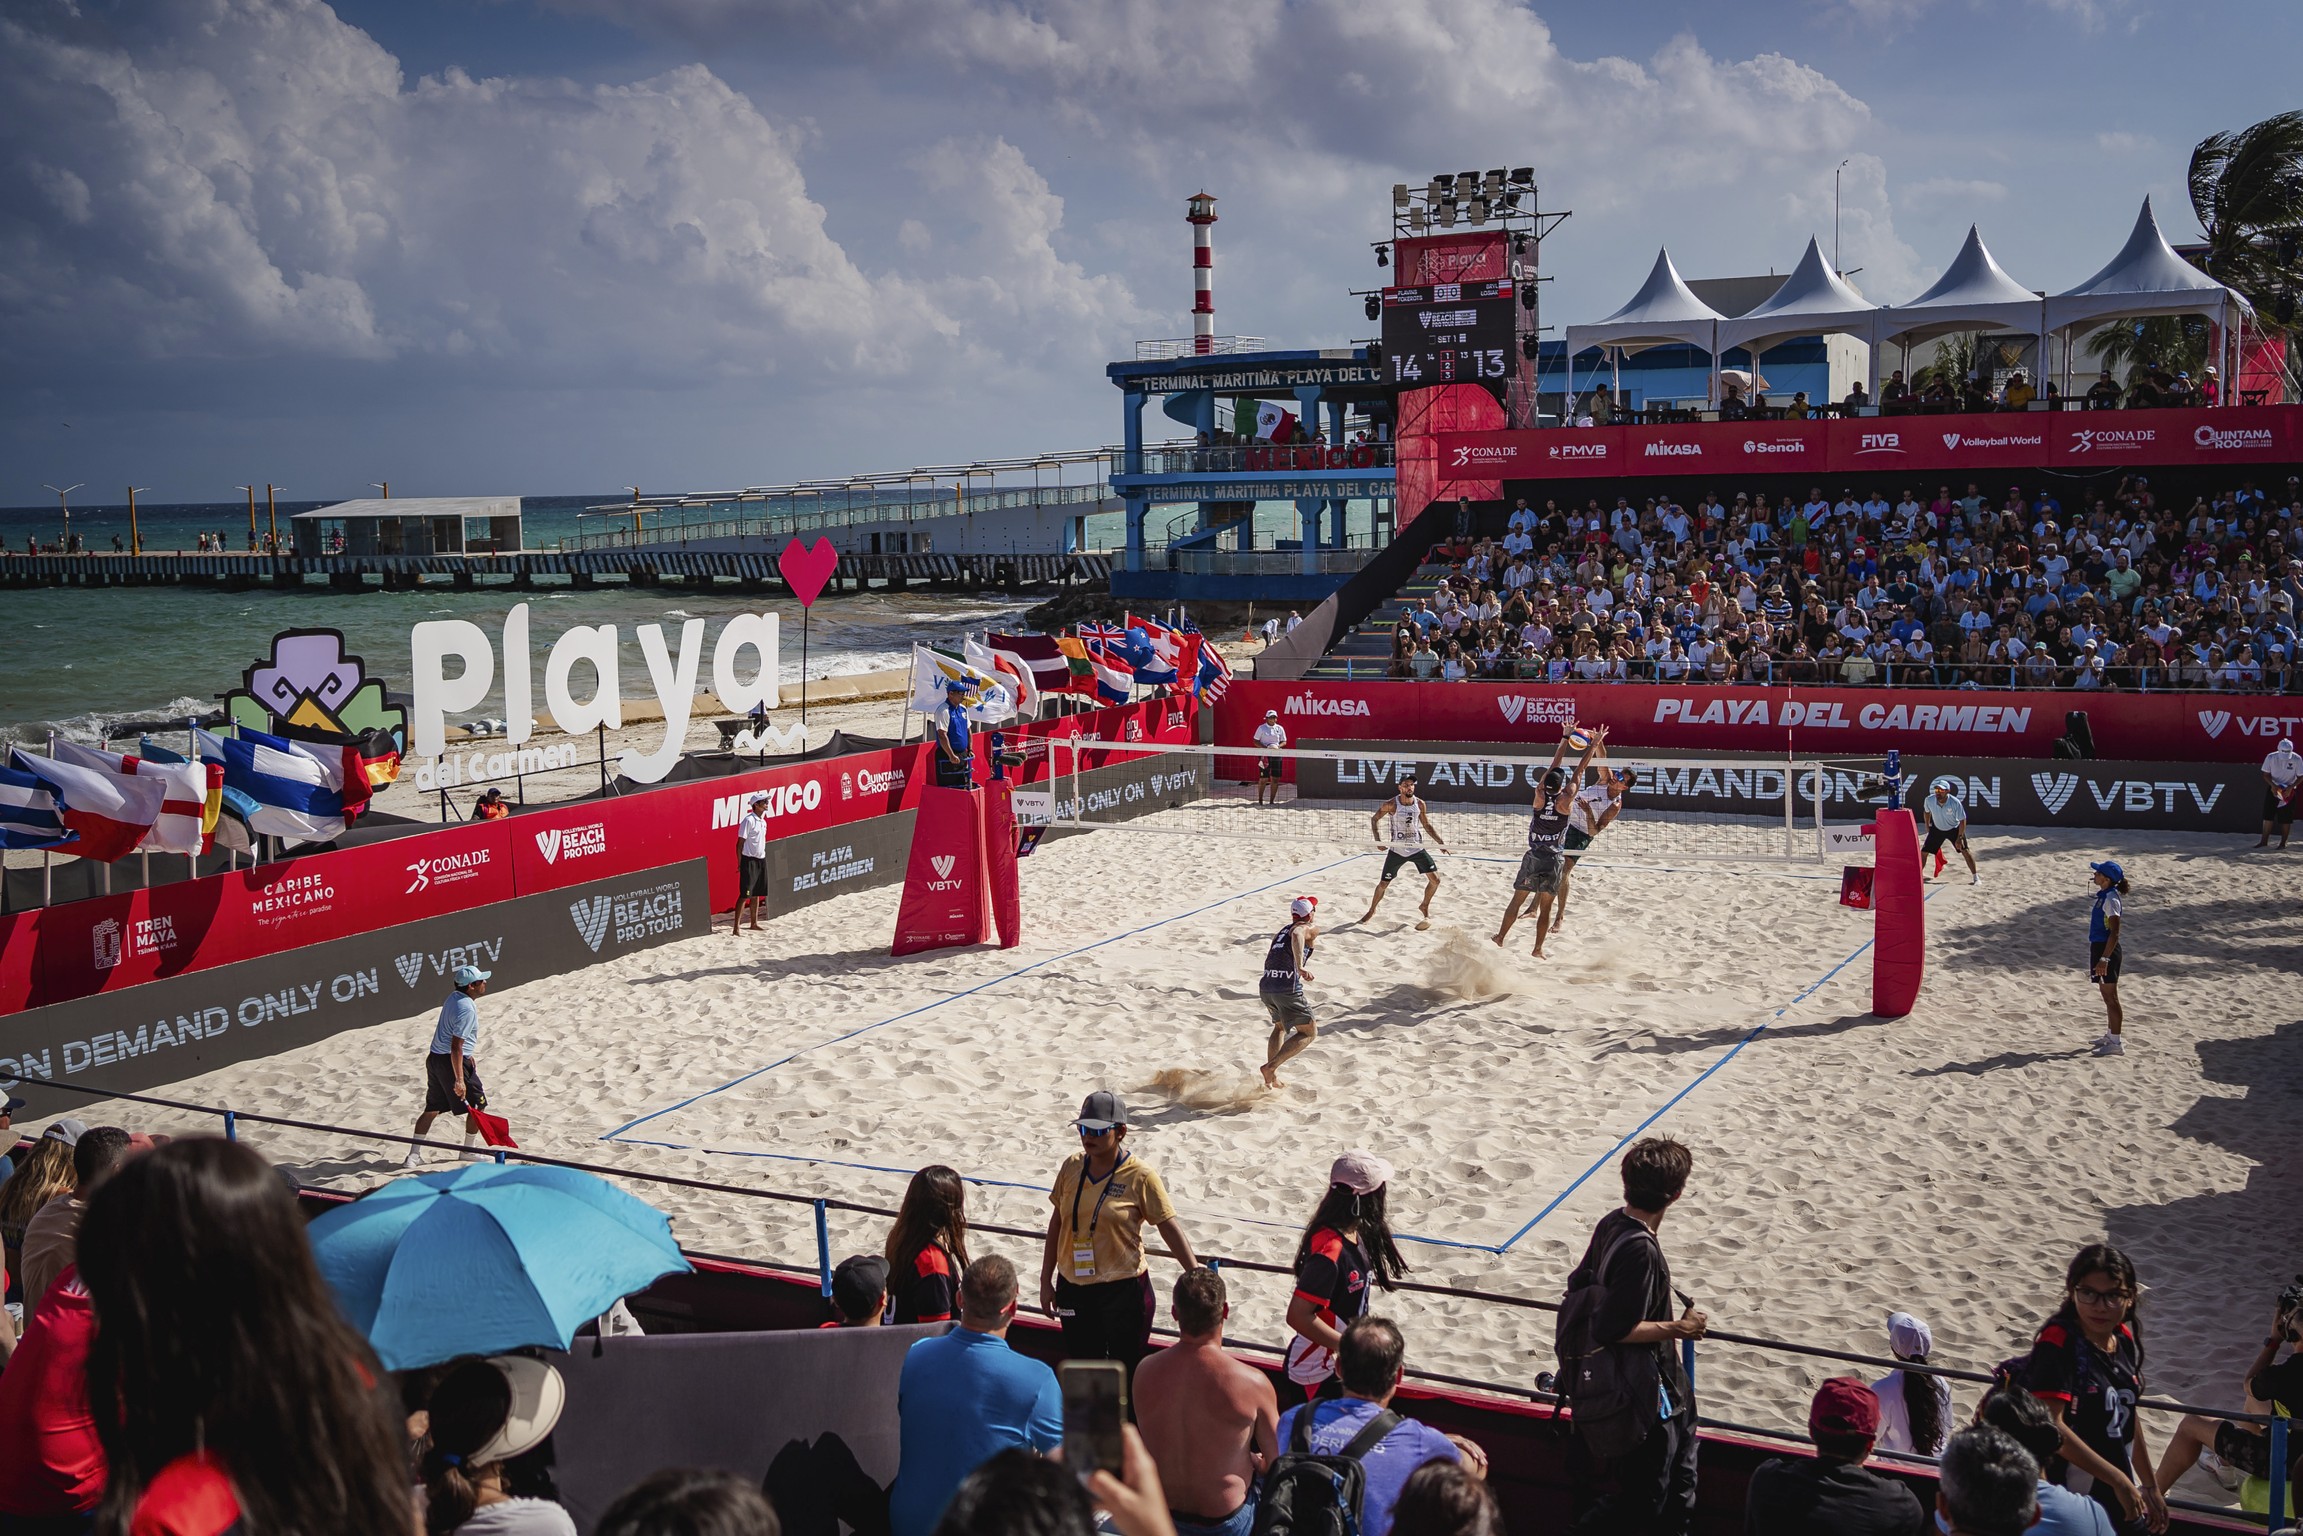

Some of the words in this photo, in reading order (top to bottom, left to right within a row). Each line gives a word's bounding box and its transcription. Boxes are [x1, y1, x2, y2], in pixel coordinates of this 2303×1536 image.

[1448, 252, 1486, 269] Playa
[1437, 287, 1445, 298] 0
[1450, 287, 1458, 297] 0
[1432, 314, 1455, 322] BEACH
[1437, 335, 1452, 343] SET
[1391, 354, 1422, 381] 14
[1473, 349, 1506, 378] 13
[1143, 375, 1207, 391] TERMINAL
[1213, 370, 1279, 389] MARITIMA
[1287, 369, 1332, 385] PLAYA
[1339, 367, 1365, 382] DEL
[1862, 433, 1899, 447] FIVB
[1962, 436, 2008, 447] Volleyball
[2010, 434, 2041, 446] World
[2096, 430, 2155, 442] CONADE
[2194, 425, 2272, 445] QUINTANA
[2215, 439, 2242, 449] ROO
[1472, 446, 1517, 457] CONADE
[1563, 444, 1607, 456] FMVB
[1757, 442, 1804, 453] Senoh
[1146, 485, 1209, 501] TERMINAL
[1215, 484, 1279, 499] MARITIMA
[1284, 482, 1330, 498] PLAYA
[1337, 482, 1362, 497] DEL
[411, 603, 780, 784] Playa
[1527, 702, 1575, 715] BEACH
[1653, 699, 1771, 725] PLAYA
[1778, 701, 1850, 728] DEL
[1859, 704, 2031, 733] CARMEN
[1527, 714, 1547, 723] PRO
[1548, 714, 1575, 724] TOUR
[2236, 716, 2303, 736] VBT
[415, 755, 460, 790] del
[468, 741, 577, 782] Carmen
[857, 769, 904, 791] QUINTANA
[871, 782, 889, 794] ROO
[1165, 769, 1196, 792] VBTV
[1337, 759, 1417, 784] LIVE
[1428, 761, 1515, 787] AND
[1629, 766, 1786, 800] EMAND
[712, 780, 822, 830] MEXICO
[1088, 787, 1122, 812] ONLY
[1124, 781, 1145, 801] ON
[1545, 801, 1554, 810] 2
[2088, 780, 2225, 814] VBTV
[1405, 816, 1413, 824] 2
[562, 826, 588, 835] VOLLEYBALL
[562, 828, 605, 849] BEACH
[432, 849, 490, 873] CONADE
[563, 848, 582, 860] PRO
[582, 842, 606, 856] TOUR
[812, 845, 853, 868] PLAYA
[793, 875, 819, 892] DEL
[820, 857, 874, 885] CARMEN
[264, 874, 322, 896] CARIBE
[613, 888, 655, 902] VOLLEYBALL
[655, 881, 680, 893] WORLD
[927, 879, 962, 892] VBTV
[252, 886, 335, 914] MEXICANO
[614, 890, 682, 927] BEACH
[135, 915, 172, 934] TREN
[257, 918, 270, 926] The
[270, 911, 308, 930] signature
[309, 904, 332, 916] paradise
[136, 928, 177, 948] MAYA
[616, 923, 645, 943] PRO
[646, 914, 683, 936] TOUR
[428, 937, 503, 976] VBTV
[0, 1048, 53, 1091] ON
[62, 1006, 229, 1074] DEMAND
[238, 980, 322, 1027] ONLY
[331, 967, 380, 1002] ON
